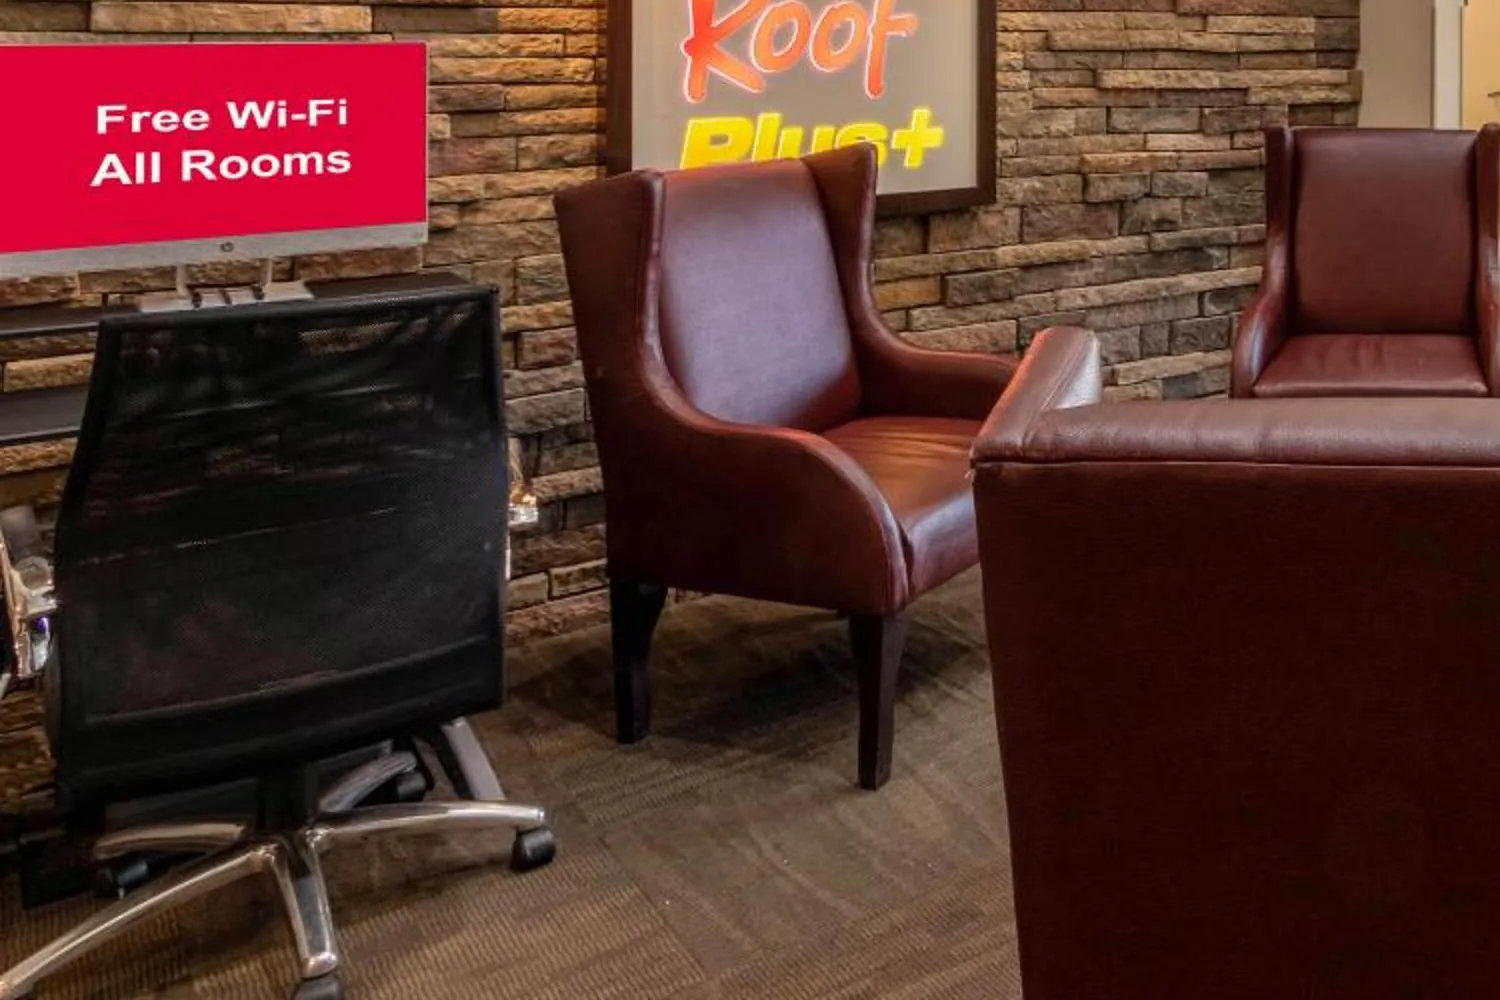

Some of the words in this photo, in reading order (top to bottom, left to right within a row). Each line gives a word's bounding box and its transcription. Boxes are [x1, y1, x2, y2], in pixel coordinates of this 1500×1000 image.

[97, 105, 209, 134] Free
[227, 99, 348, 129] Wi-Fi
[90, 152, 161, 187] All
[182, 149, 351, 181] Rooms
